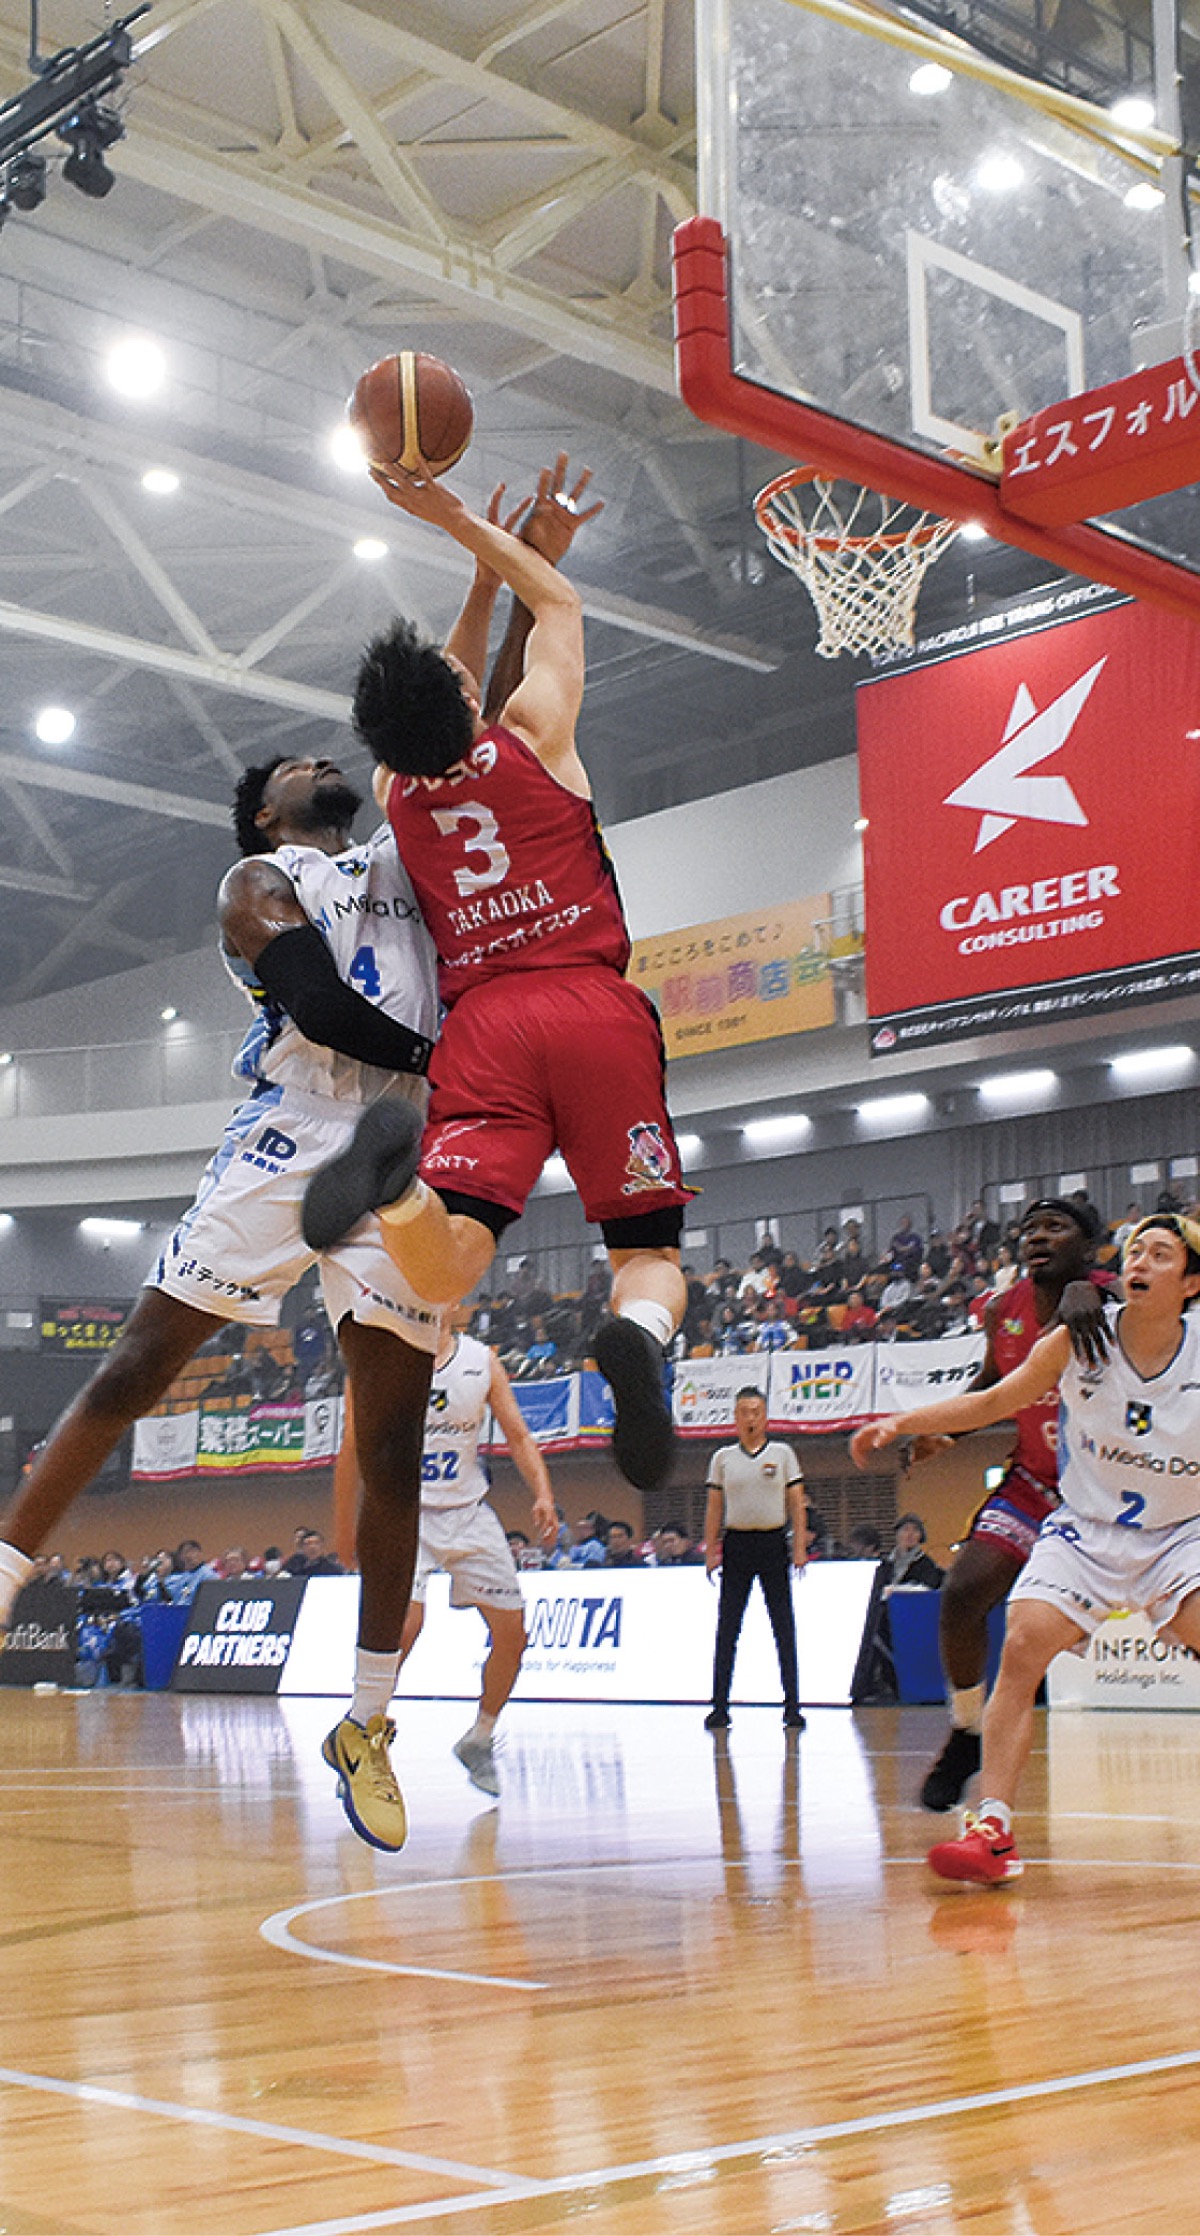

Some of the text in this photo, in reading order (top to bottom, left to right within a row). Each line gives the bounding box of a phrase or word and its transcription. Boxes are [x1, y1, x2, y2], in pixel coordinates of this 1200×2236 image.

[430, 801, 510, 897] 3
[448, 879, 554, 936] TAKAOKA
[940, 864, 1121, 931] CAREER
[958, 909, 1104, 955] CONSULTING
[350, 946, 381, 996] 4
[424, 1154, 480, 1171] ENTY
[791, 1360, 853, 1399] NEP
[420, 1450, 459, 1481] 52
[1116, 1489, 1146, 1530] 2
[215, 1599, 274, 1632] CLUB
[484, 1597, 624, 1649] NITA
[3, 1622, 71, 1650] oftBank
[180, 1634, 291, 1667] PARTNERS
[1095, 1669, 1157, 1689] Holdings
